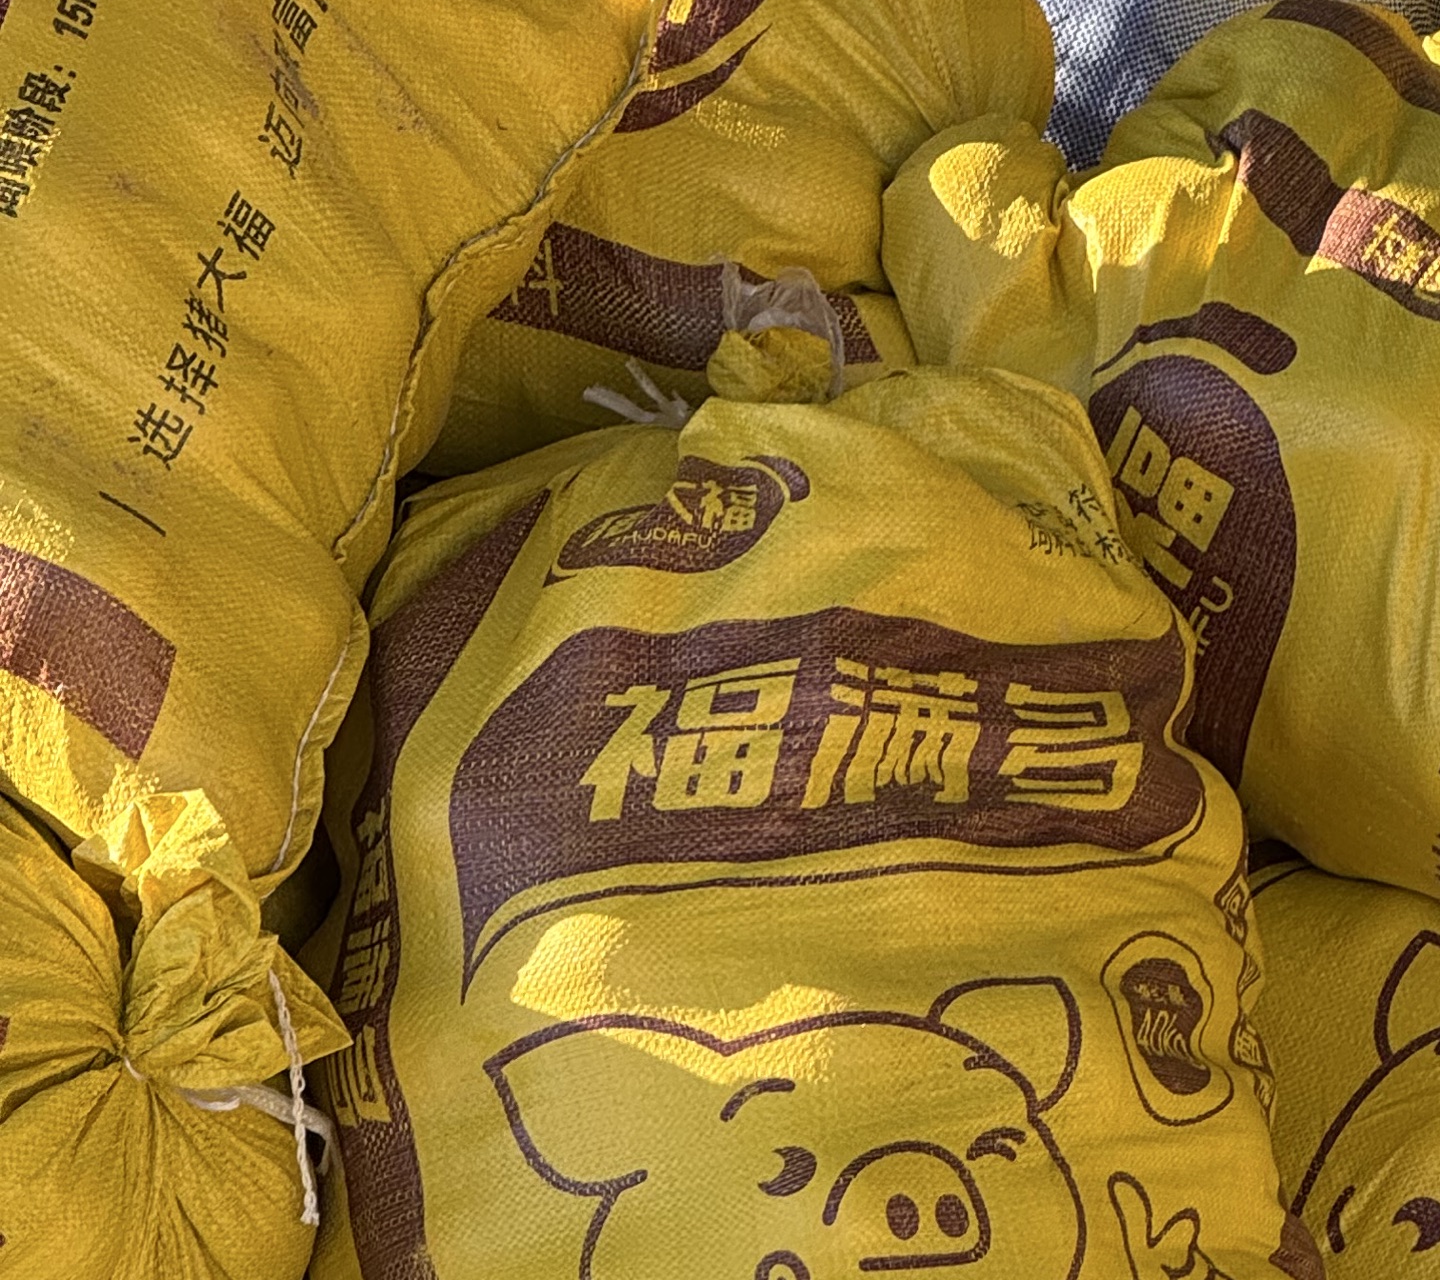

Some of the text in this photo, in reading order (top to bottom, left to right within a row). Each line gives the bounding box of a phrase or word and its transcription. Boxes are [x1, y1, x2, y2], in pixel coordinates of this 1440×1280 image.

[127, 191, 276, 470] 选择猪大福
[580, 656, 1144, 823] 福满多
